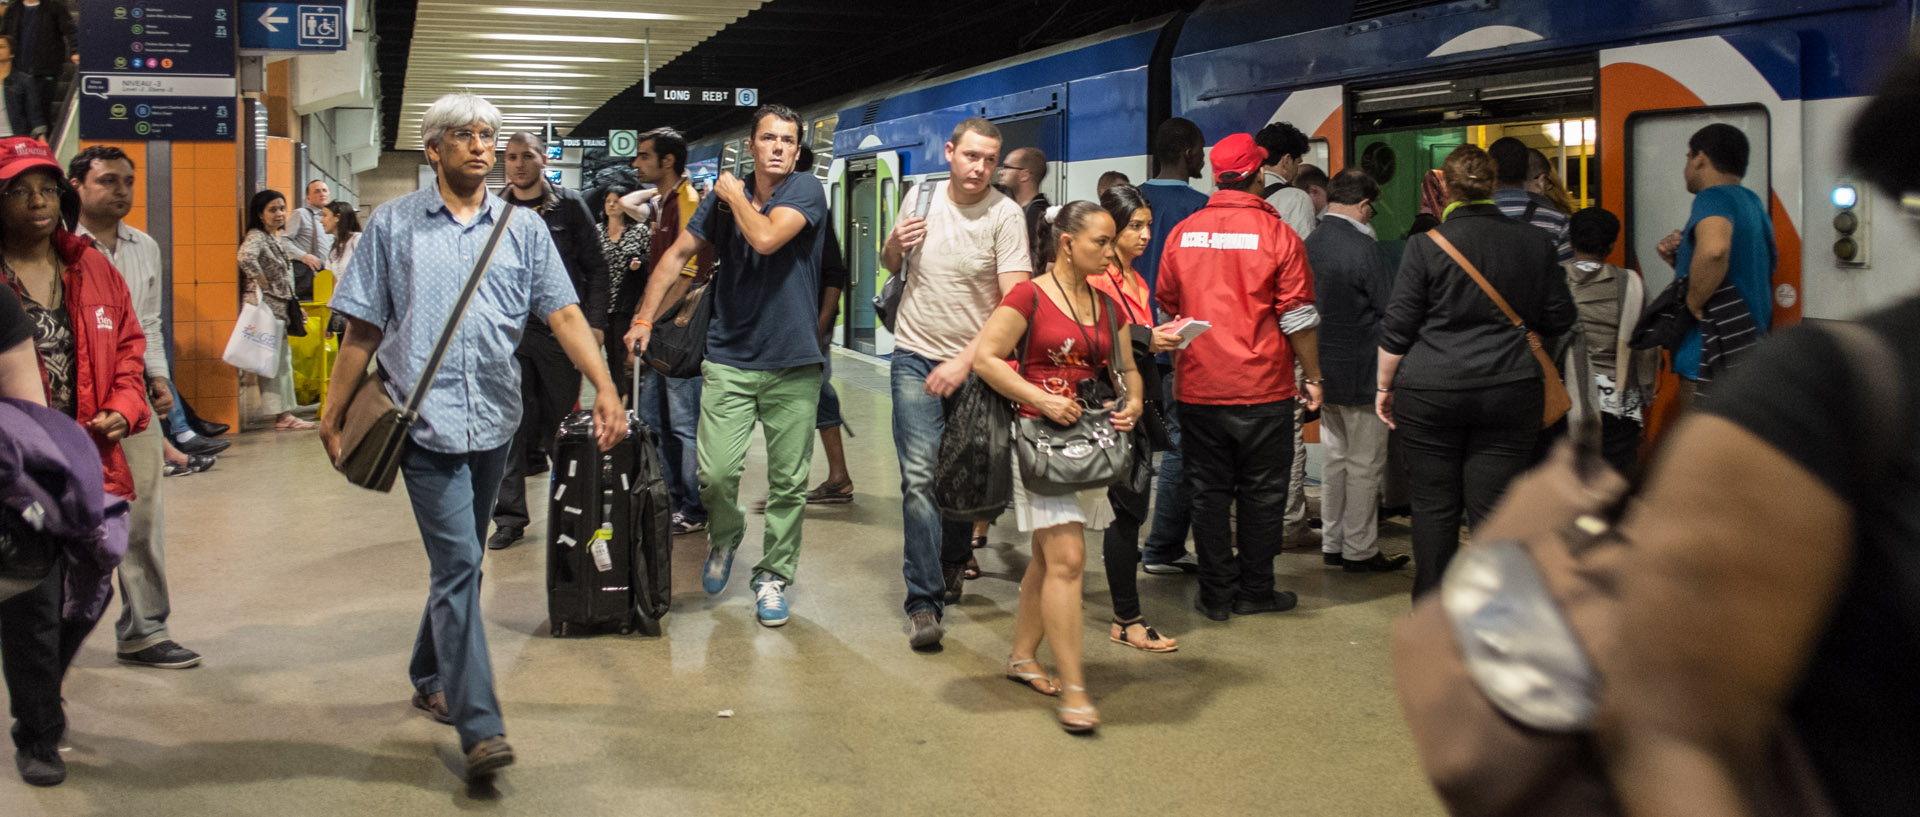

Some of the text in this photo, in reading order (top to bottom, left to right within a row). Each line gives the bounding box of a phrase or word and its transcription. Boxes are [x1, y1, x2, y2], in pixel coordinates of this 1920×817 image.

[664, 90, 690, 101] LONG
[563, 139, 607, 147] TOUS TRAINS
[618, 137, 630, 150] D
